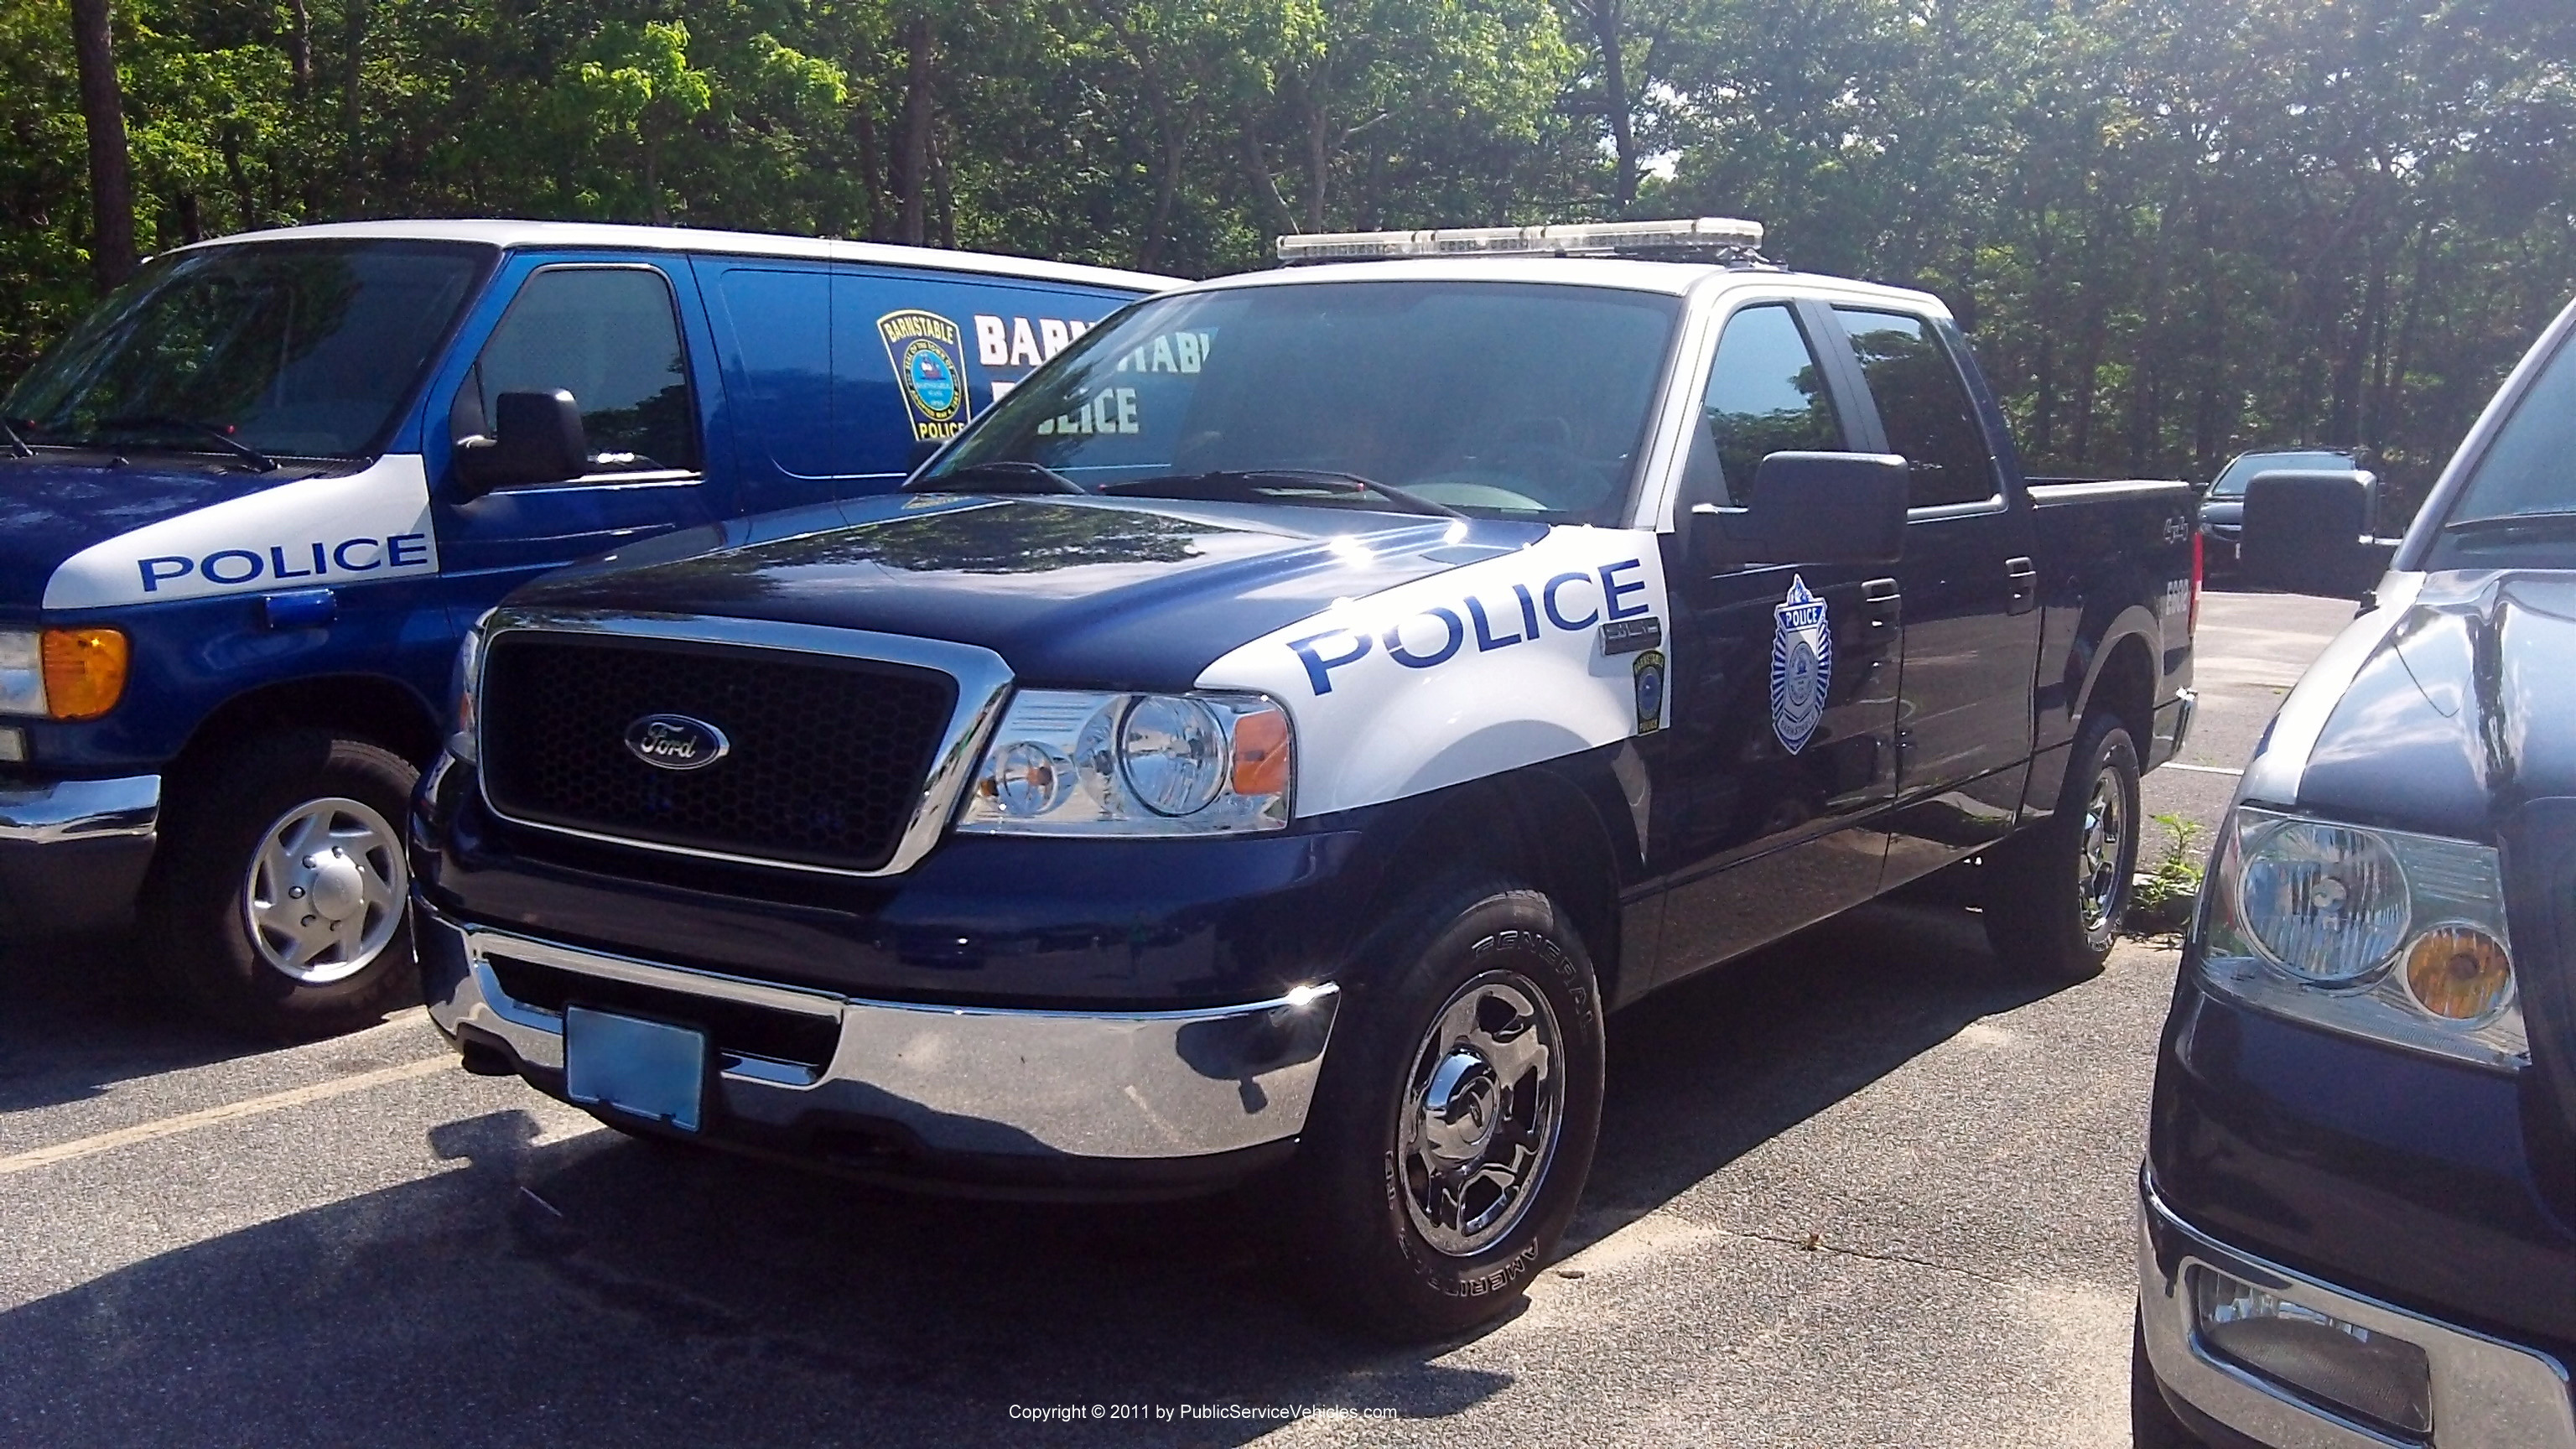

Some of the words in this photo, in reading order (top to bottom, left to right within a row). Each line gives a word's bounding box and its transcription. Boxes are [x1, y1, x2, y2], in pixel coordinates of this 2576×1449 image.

[883, 315, 953, 345] BARNSTABLE
[974, 314, 1212, 373] BARAB
[992, 382, 1140, 434] LICE
[137, 533, 428, 592] POLICE
[1286, 558, 1649, 696] POLICE
[1785, 606, 1818, 628] POLICE
[641, 723, 697, 758] Ford
